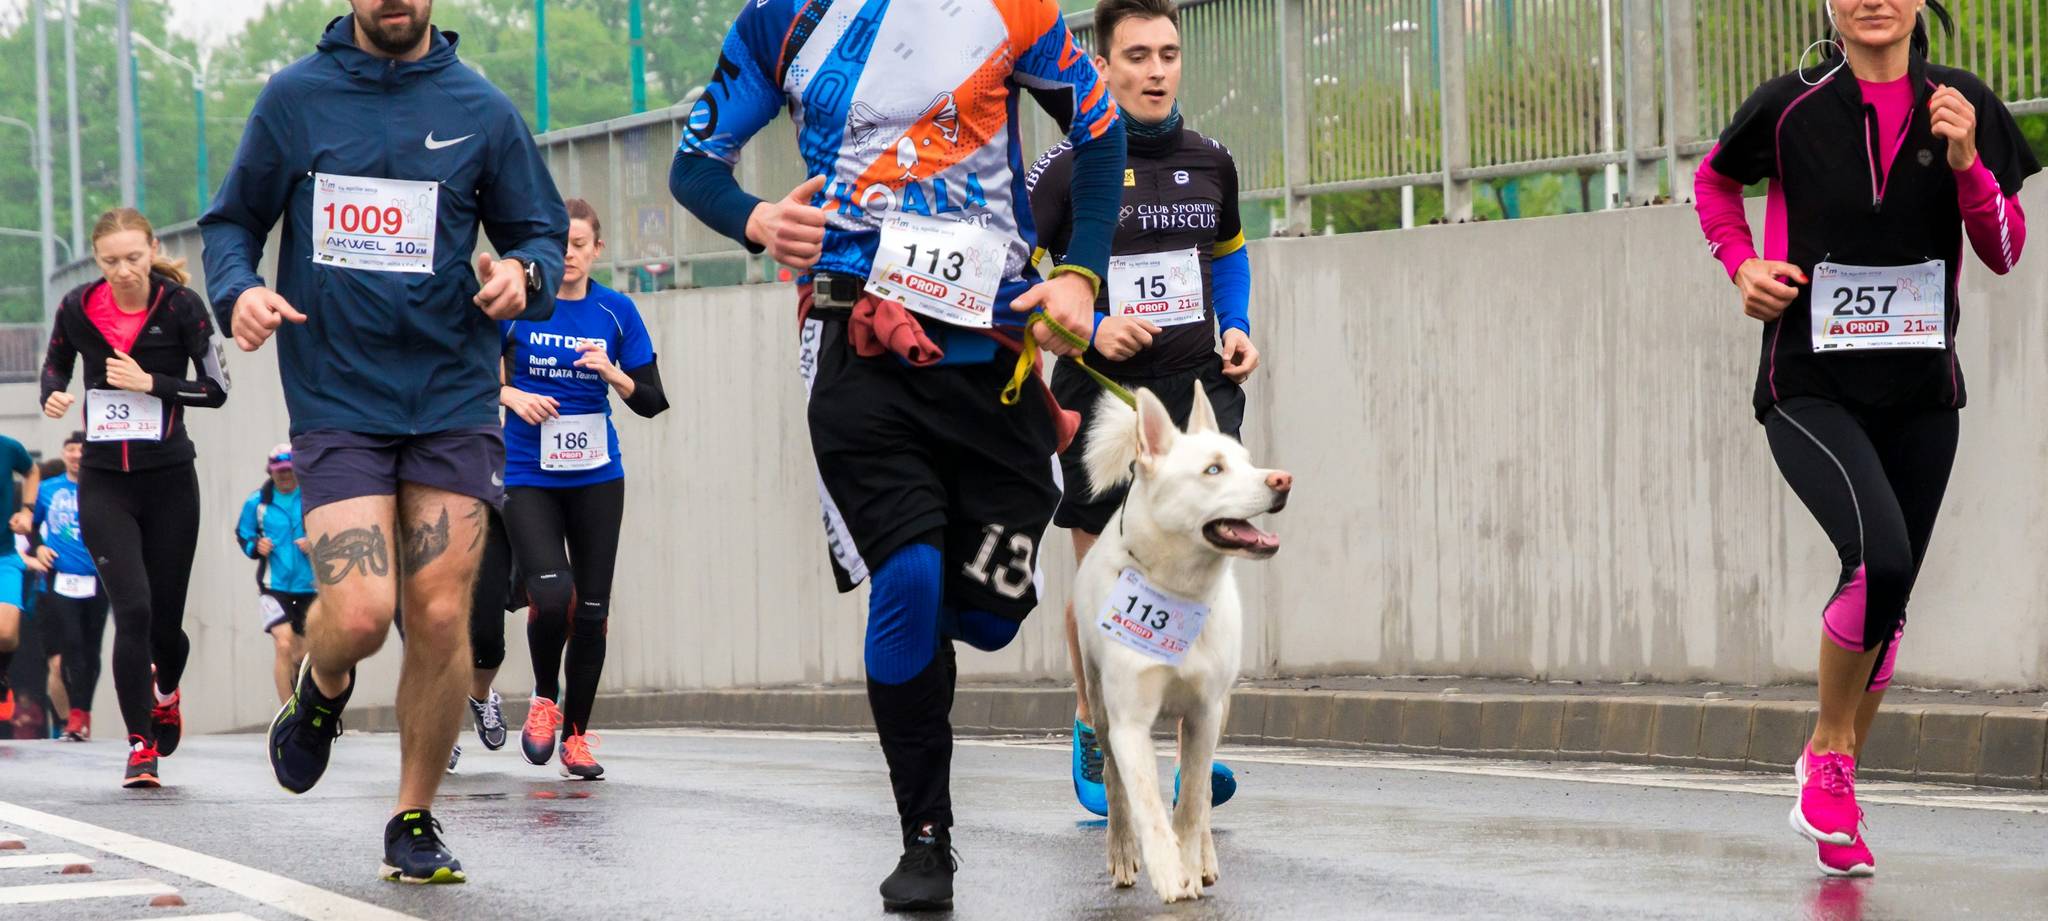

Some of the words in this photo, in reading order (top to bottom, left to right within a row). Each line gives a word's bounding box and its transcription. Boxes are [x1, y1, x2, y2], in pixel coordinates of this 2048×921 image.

[1025, 139, 1073, 192] IBISCU
[834, 172, 988, 218] KOALA
[323, 202, 403, 235] 1009
[1137, 204, 1169, 215] CLUB
[1172, 203, 1215, 214] SPORTIV
[1137, 214, 1216, 230] TIBISCUS
[327, 237, 386, 251] AKWEL
[903, 243, 965, 282] 113
[909, 276, 945, 298] PROFI
[1134, 274, 1167, 299] 15
[1139, 302, 1168, 312] PROFI
[1832, 286, 1898, 316] 257
[1850, 322, 1886, 333] PROFI
[529, 331, 564, 348] NTT
[529, 354, 558, 366] Run@
[528, 367, 547, 377] NTT
[549, 368, 573, 379] DATA
[576, 370, 598, 380] Team
[105, 403, 130, 420] 33
[553, 431, 588, 450] 186
[961, 523, 1033, 599] 13
[1126, 595, 1170, 630] 113
